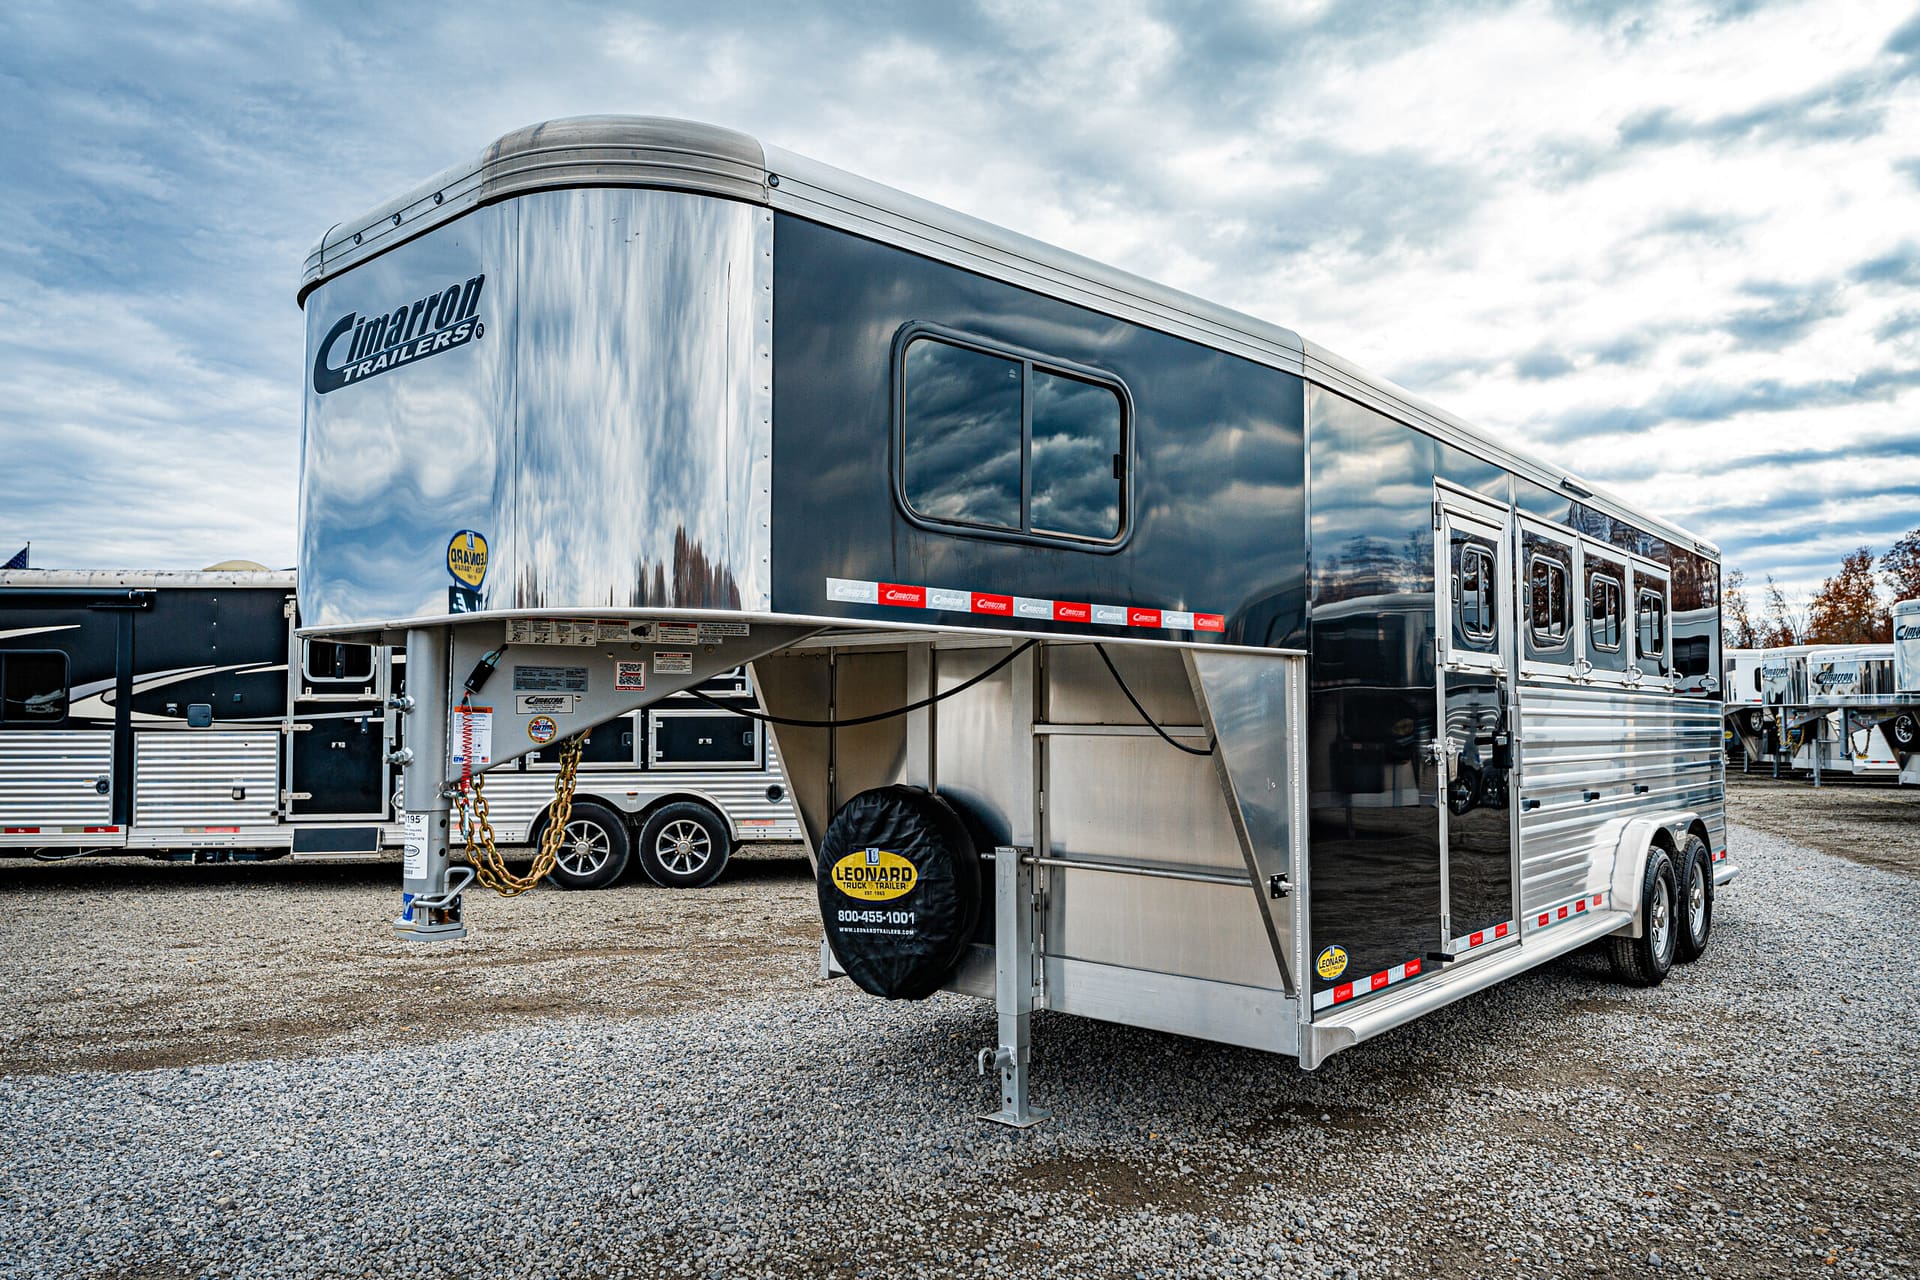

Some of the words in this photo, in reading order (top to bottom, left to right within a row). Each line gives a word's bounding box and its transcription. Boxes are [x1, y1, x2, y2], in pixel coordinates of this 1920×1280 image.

[313, 273, 486, 395] Cimarron
[342, 322, 472, 383] TRAILERS
[836, 867, 912, 881] LEONARD
[838, 910, 915, 924] 800-455-1001
[1319, 953, 1346, 969] LEONARD
